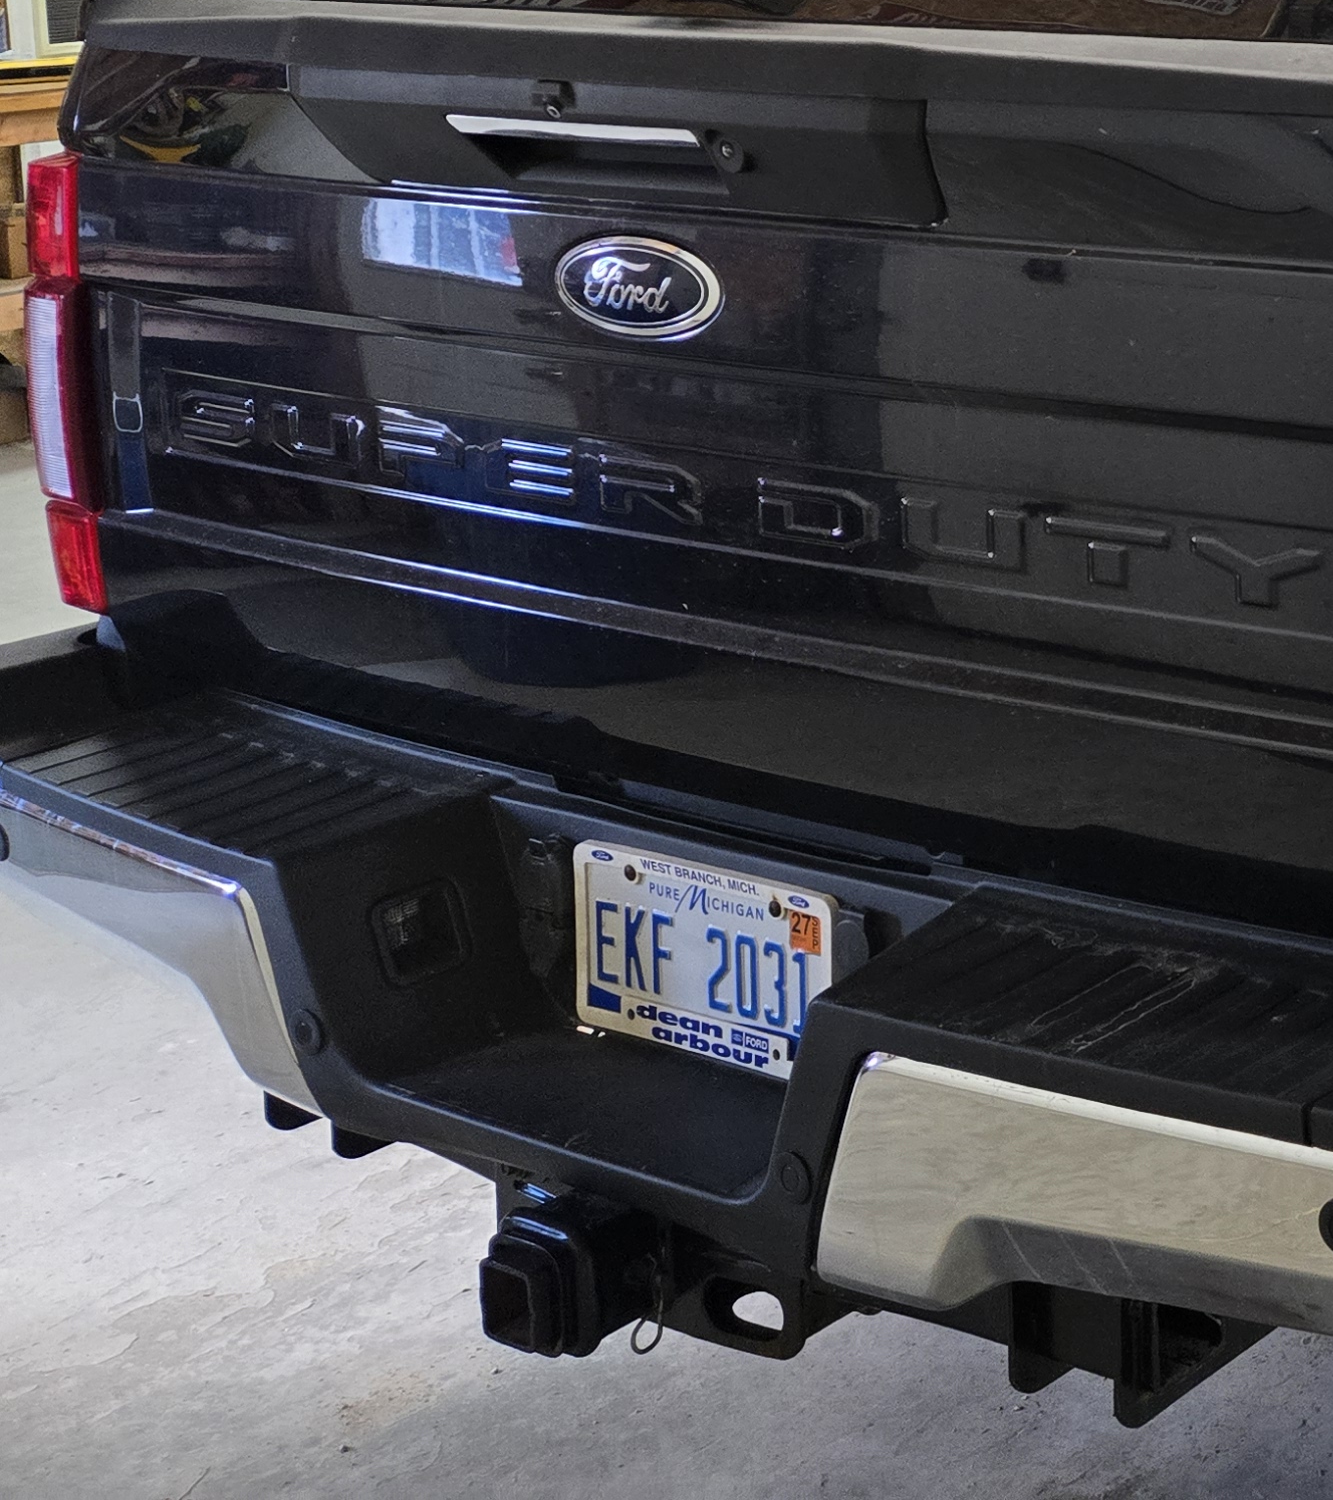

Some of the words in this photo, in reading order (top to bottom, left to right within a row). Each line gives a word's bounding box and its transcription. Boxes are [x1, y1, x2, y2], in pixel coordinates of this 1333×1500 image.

[583, 255, 673, 315] Ford
[176, 388, 704, 526] SUPER
[757, 475, 1326, 610] DUTY
[639, 857, 672, 876] WEST
[674, 865, 726, 891] BRANCH,
[726, 878, 760, 897] MICH.
[649, 881, 681, 901] PURE
[674, 883, 766, 922] MICHIGAN
[791, 911, 812, 936] 27
[811, 916, 820, 950] SEP
[595, 897, 674, 995] EKF
[706, 924, 810, 1037] 2031
[634, 1003, 725, 1039] dean
[651, 1025, 770, 1070] arbour
[744, 1032, 769, 1052] FORD
